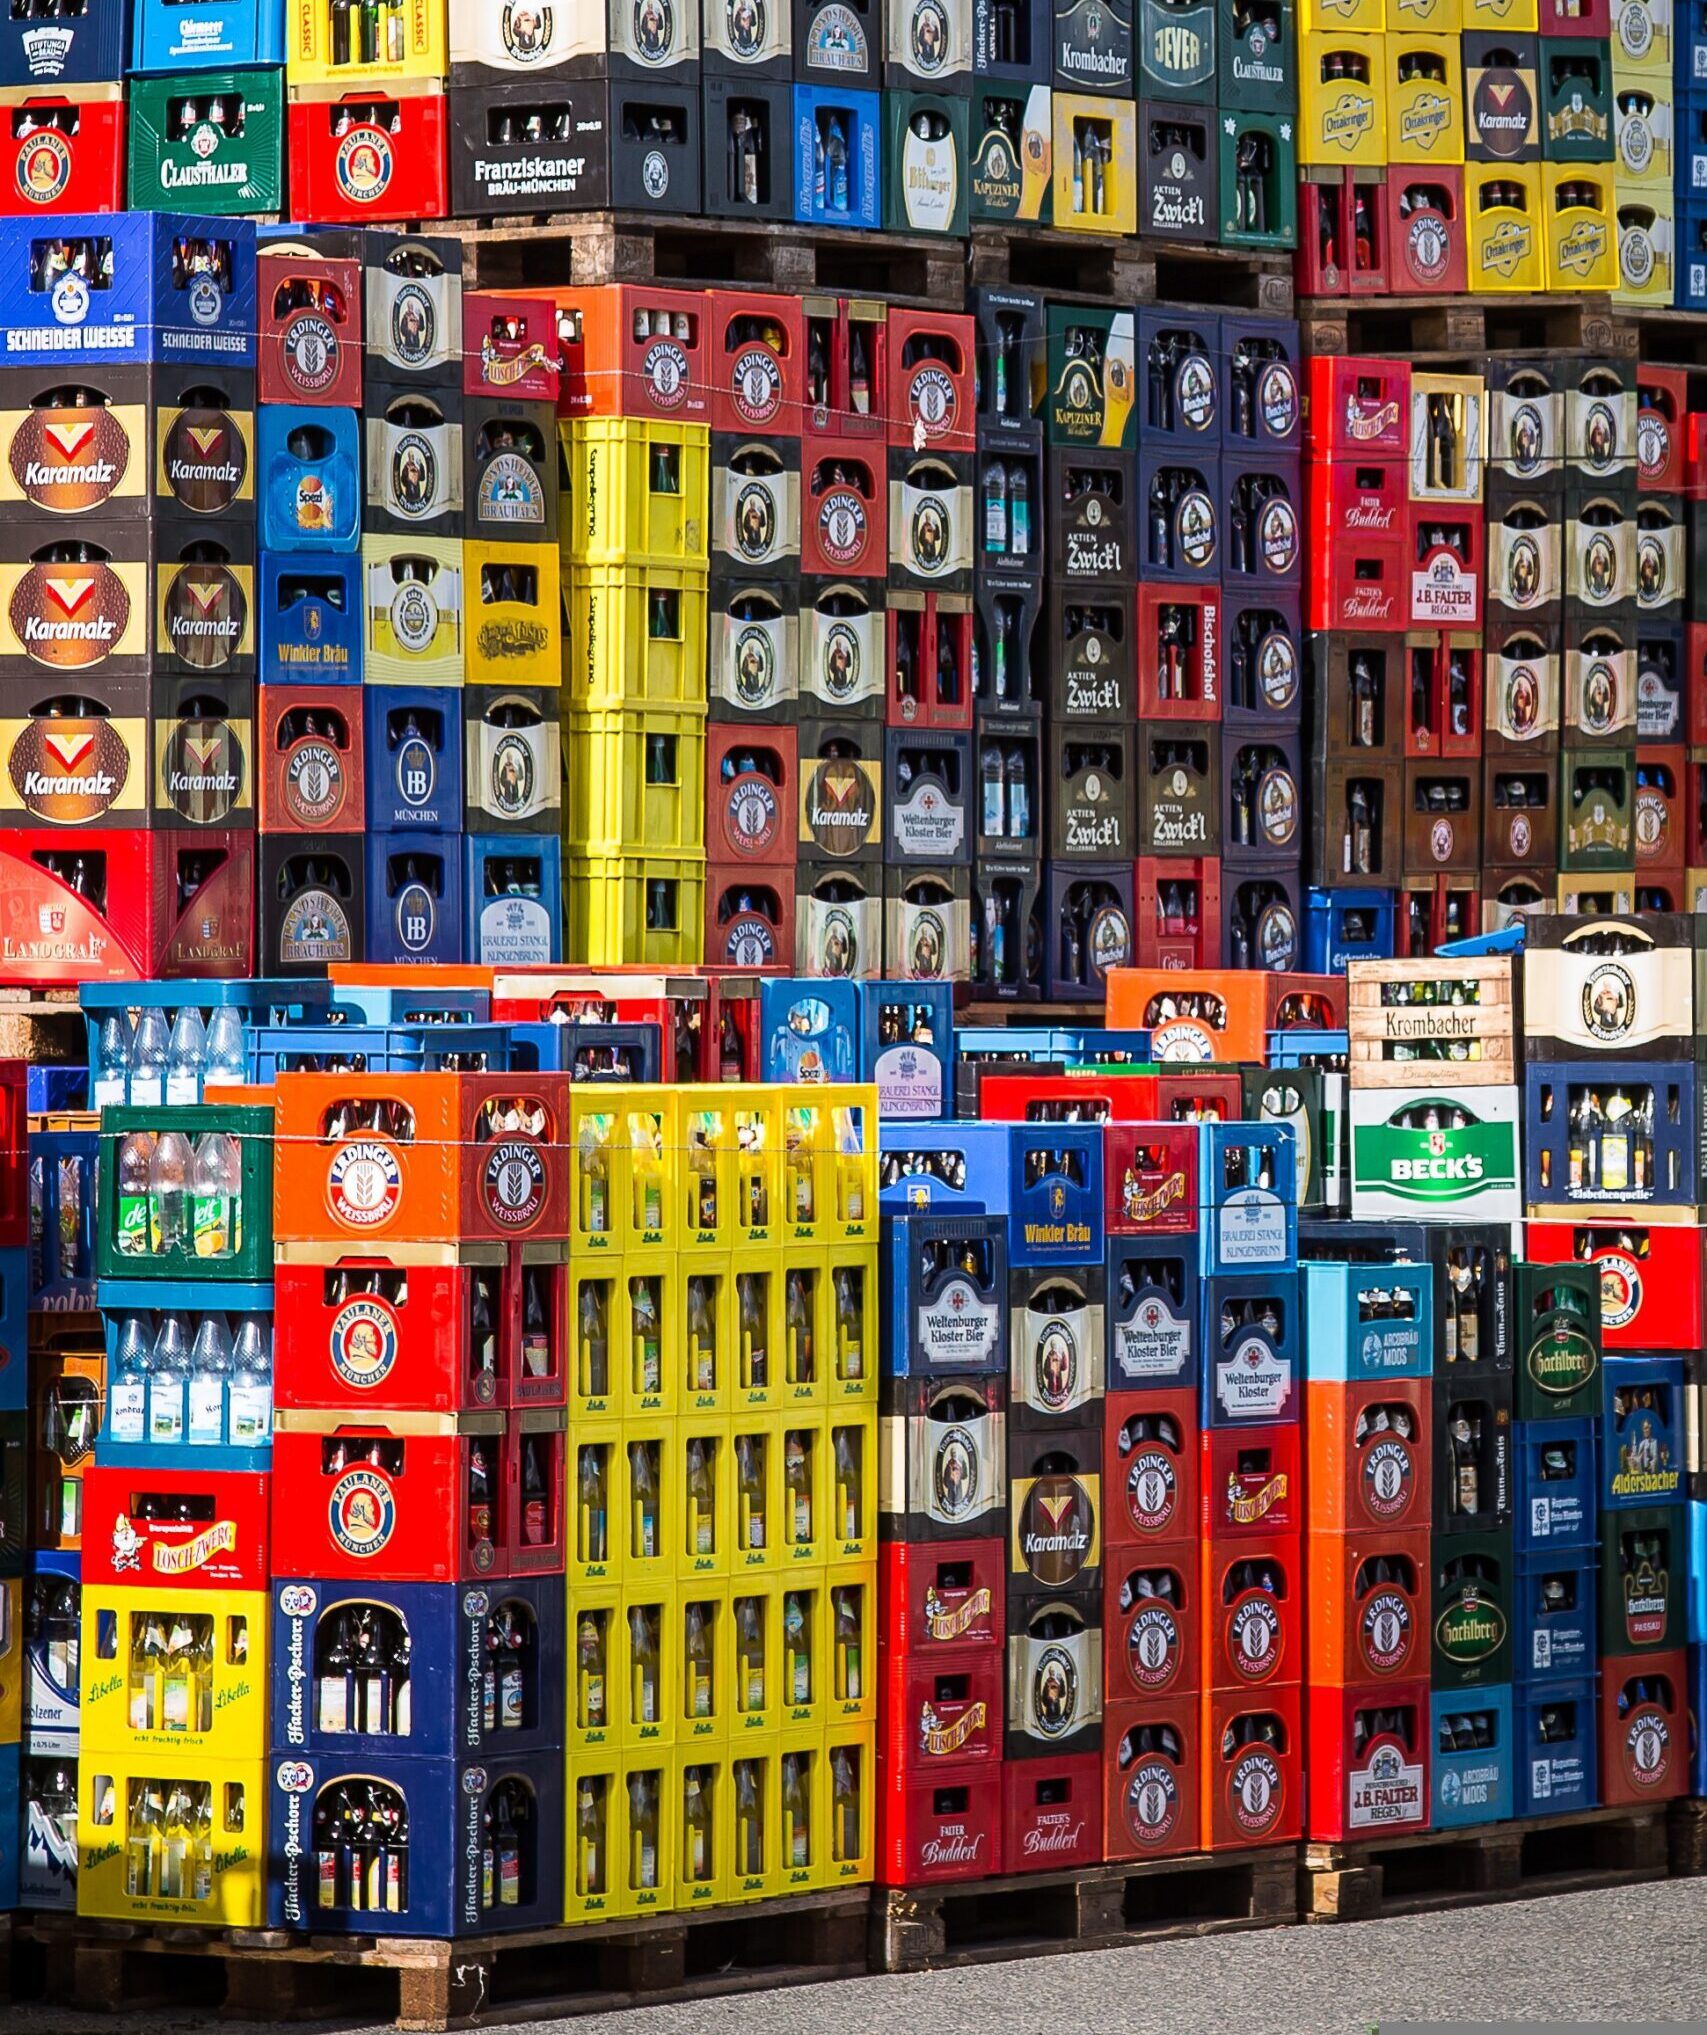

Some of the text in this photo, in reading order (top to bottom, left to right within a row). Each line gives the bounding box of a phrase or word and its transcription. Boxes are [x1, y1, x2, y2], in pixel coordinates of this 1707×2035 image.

[301, 4, 312, 54] CLASSIC
[1062, 42, 1128, 75] Krombacher
[1155, 27, 1200, 70] JEVER
[1233, 56, 1284, 83] CLAUSTHALER
[1326, 111, 1369, 131] Ottakringer
[1402, 108, 1447, 131] Ottakringer
[1479, 112, 1526, 130] Karamalz
[20, 135, 66, 161] PAULANER
[341, 131, 388, 158] PAULANER
[161, 160, 248, 188] CLAUSTHALER
[475, 157, 585, 181] Franziskaner
[488, 178, 576, 196] BRÄU-MÜNCHEN
[973, 179, 1021, 198] KAPUZINER
[1154, 186, 1181, 197] AKTIEN
[1410, 216, 1448, 246] ERDINGER
[7, 326, 134, 351] SCHNEIDER WEISSE
[162, 332, 246, 352] SCHNEIDER WEISSE
[287, 319, 335, 350] ERDINGER
[644, 342, 688, 376] ERDINGER
[733, 350, 779, 384] ERDINGER
[911, 368, 955, 400] ERDINGER
[1055, 408, 1103, 425] KAPUZINER
[25, 460, 111, 484] Karamalz
[170, 459, 237, 481] Karamalz
[820, 493, 864, 526] ERDINGER
[1067, 533, 1096, 543] AKTIEN
[1436, 590, 1472, 605] FALTER
[1431, 605, 1457, 615] REGEN
[25, 616, 112, 640] Karamalz
[172, 615, 237, 636] Karamalz
[278, 643, 348, 662] Winkler Bräu
[1203, 604, 1217, 702] Bischofshof
[1067, 672, 1096, 681] AKTIEN
[290, 748, 339, 778] ERDINGER
[25, 772, 111, 795] Karamalz
[170, 771, 235, 791] Karamalz
[406, 770, 426, 796] HB
[730, 781, 775, 813] ERDINGER
[1153, 804, 1183, 813] AKTIEN
[394, 807, 438, 821] MÜNCHEN
[812, 807, 868, 827] Karamalz
[901, 813, 956, 829] Weltenburger
[905, 827, 953, 839] Kloster Bier
[406, 916, 426, 941] HB
[726, 922, 773, 952] ERDINGER
[3, 937, 100, 960] LANDGRAF
[177, 942, 244, 958] LANDGRAF
[482, 935, 548, 947] BRAUEREI STANGL
[1162, 954, 1186, 969] Coke
[1386, 1011, 1476, 1036] Krombacher
[1153, 1026, 1211, 1057] ERDINGER
[879, 1085, 939, 1097] RAUEREI STANGL
[332, 1144, 398, 1178] ERDINGER
[488, 1144, 541, 1177] ERDINGER
[1391, 1154, 1483, 1181] BECK'S
[1024, 1223, 1091, 1243] Winkler Bräu
[1222, 1230, 1284, 1242] BRAUEREI STANGL
[41, 1286, 97, 1312] volvi
[334, 1304, 393, 1335] PAULANER
[926, 1315, 989, 1331] Weltenburger
[930, 1328, 985, 1343] Kloster Bier
[1123, 1329, 1182, 1345] Weltenburger
[1383, 1331, 1419, 1348] ARCOBRÄU
[1127, 1343, 1178, 1358] Kloster Bier
[1383, 1347, 1407, 1366] MOOS
[1225, 1371, 1282, 1386] Weltenburger
[1237, 1385, 1269, 1398] Kloster
[1366, 1442, 1409, 1474] ERDINGER
[1128, 1455, 1173, 1486] ERDINGER
[1611, 1470, 1679, 1495] Aldersbacher
[333, 1472, 391, 1504] PAULANER
[1025, 1531, 1086, 1553] Karamalz
[1232, 1602, 1280, 1637] ERDINGER
[1365, 1596, 1409, 1627] ERDINGER
[1130, 1610, 1176, 1642] ERDINGER
[1634, 1622, 1661, 1633] PASSAU
[87, 1676, 123, 1703] Libella
[287, 1618, 304, 1745] Hacker-Pschorr
[467, 1620, 480, 1747] Hacker-Pschorr
[214, 1682, 250, 1710] Libella
[1627, 1713, 1668, 1746] ERDINGER
[1129, 1766, 1175, 1799] ERDINGER
[1233, 1756, 1279, 1791] ERDINGER
[1462, 1767, 1498, 1785] ARCOBRÄU
[1353, 1787, 1418, 1809] J.B. FALTER
[1462, 1784, 1488, 1804] MOOS
[1371, 1805, 1402, 1819] REGEN
[83, 1844, 122, 1871] Libella
[285, 1795, 301, 1922] Hacker-Pschorr
[465, 1797, 478, 1924] Hacker-Pschorr
